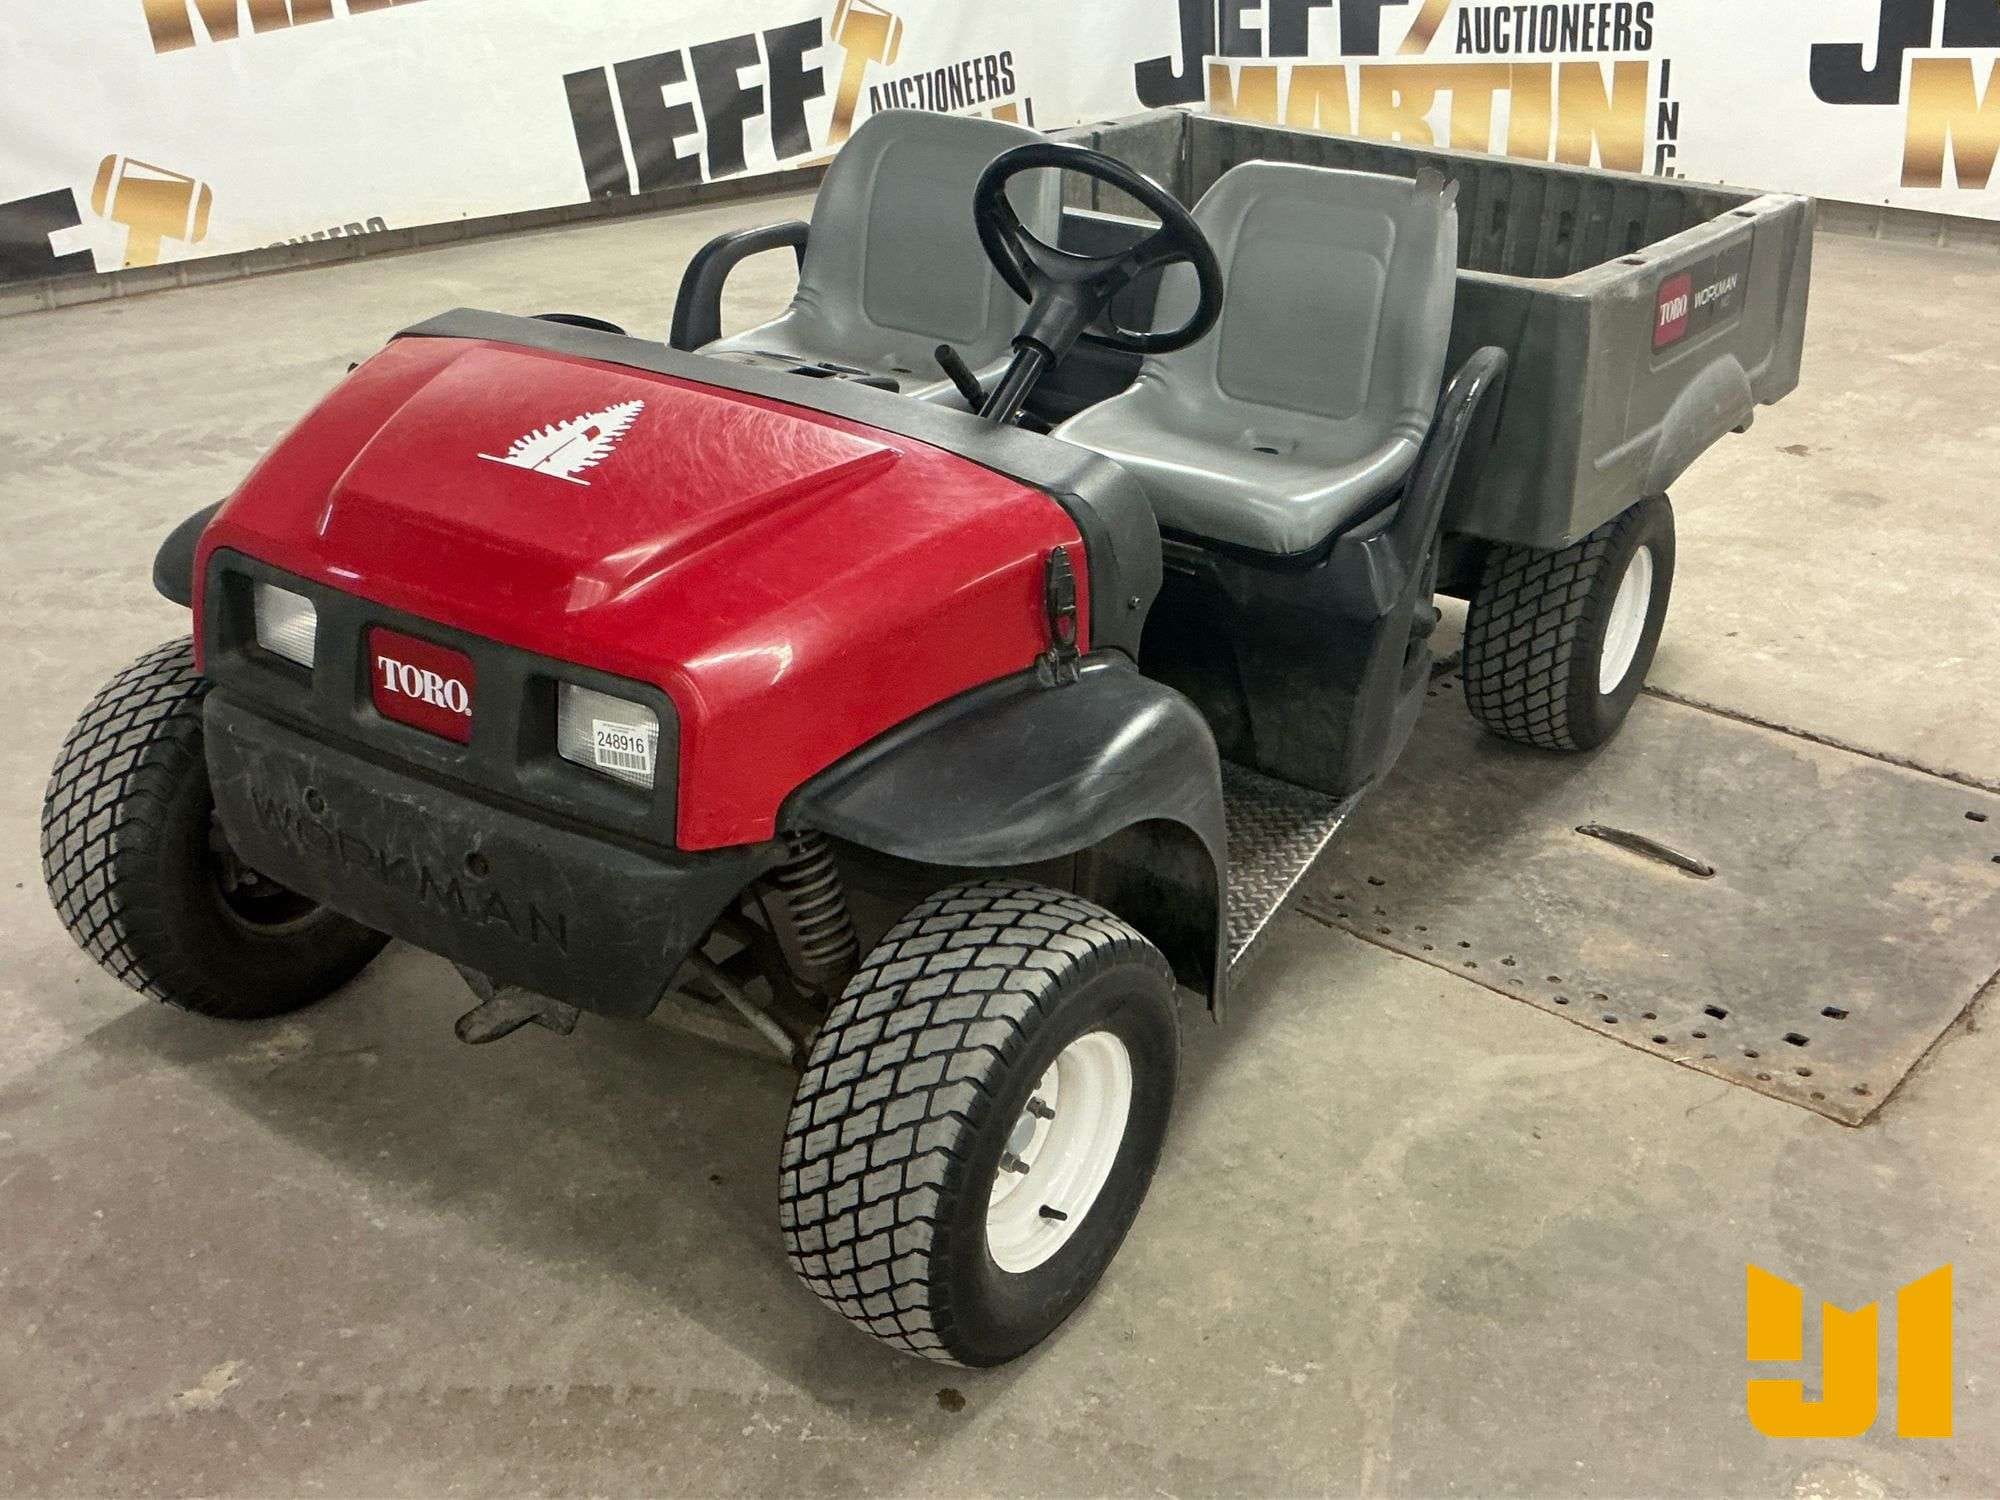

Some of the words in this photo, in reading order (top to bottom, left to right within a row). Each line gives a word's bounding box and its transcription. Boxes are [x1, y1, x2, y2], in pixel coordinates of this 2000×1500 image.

[1455, 2, 1654, 54] AUCTIONEERS
[869, 50, 1016, 117] AUCTIONEERS
[378, 655, 469, 714] TORO
[597, 731, 645, 754] 248916
